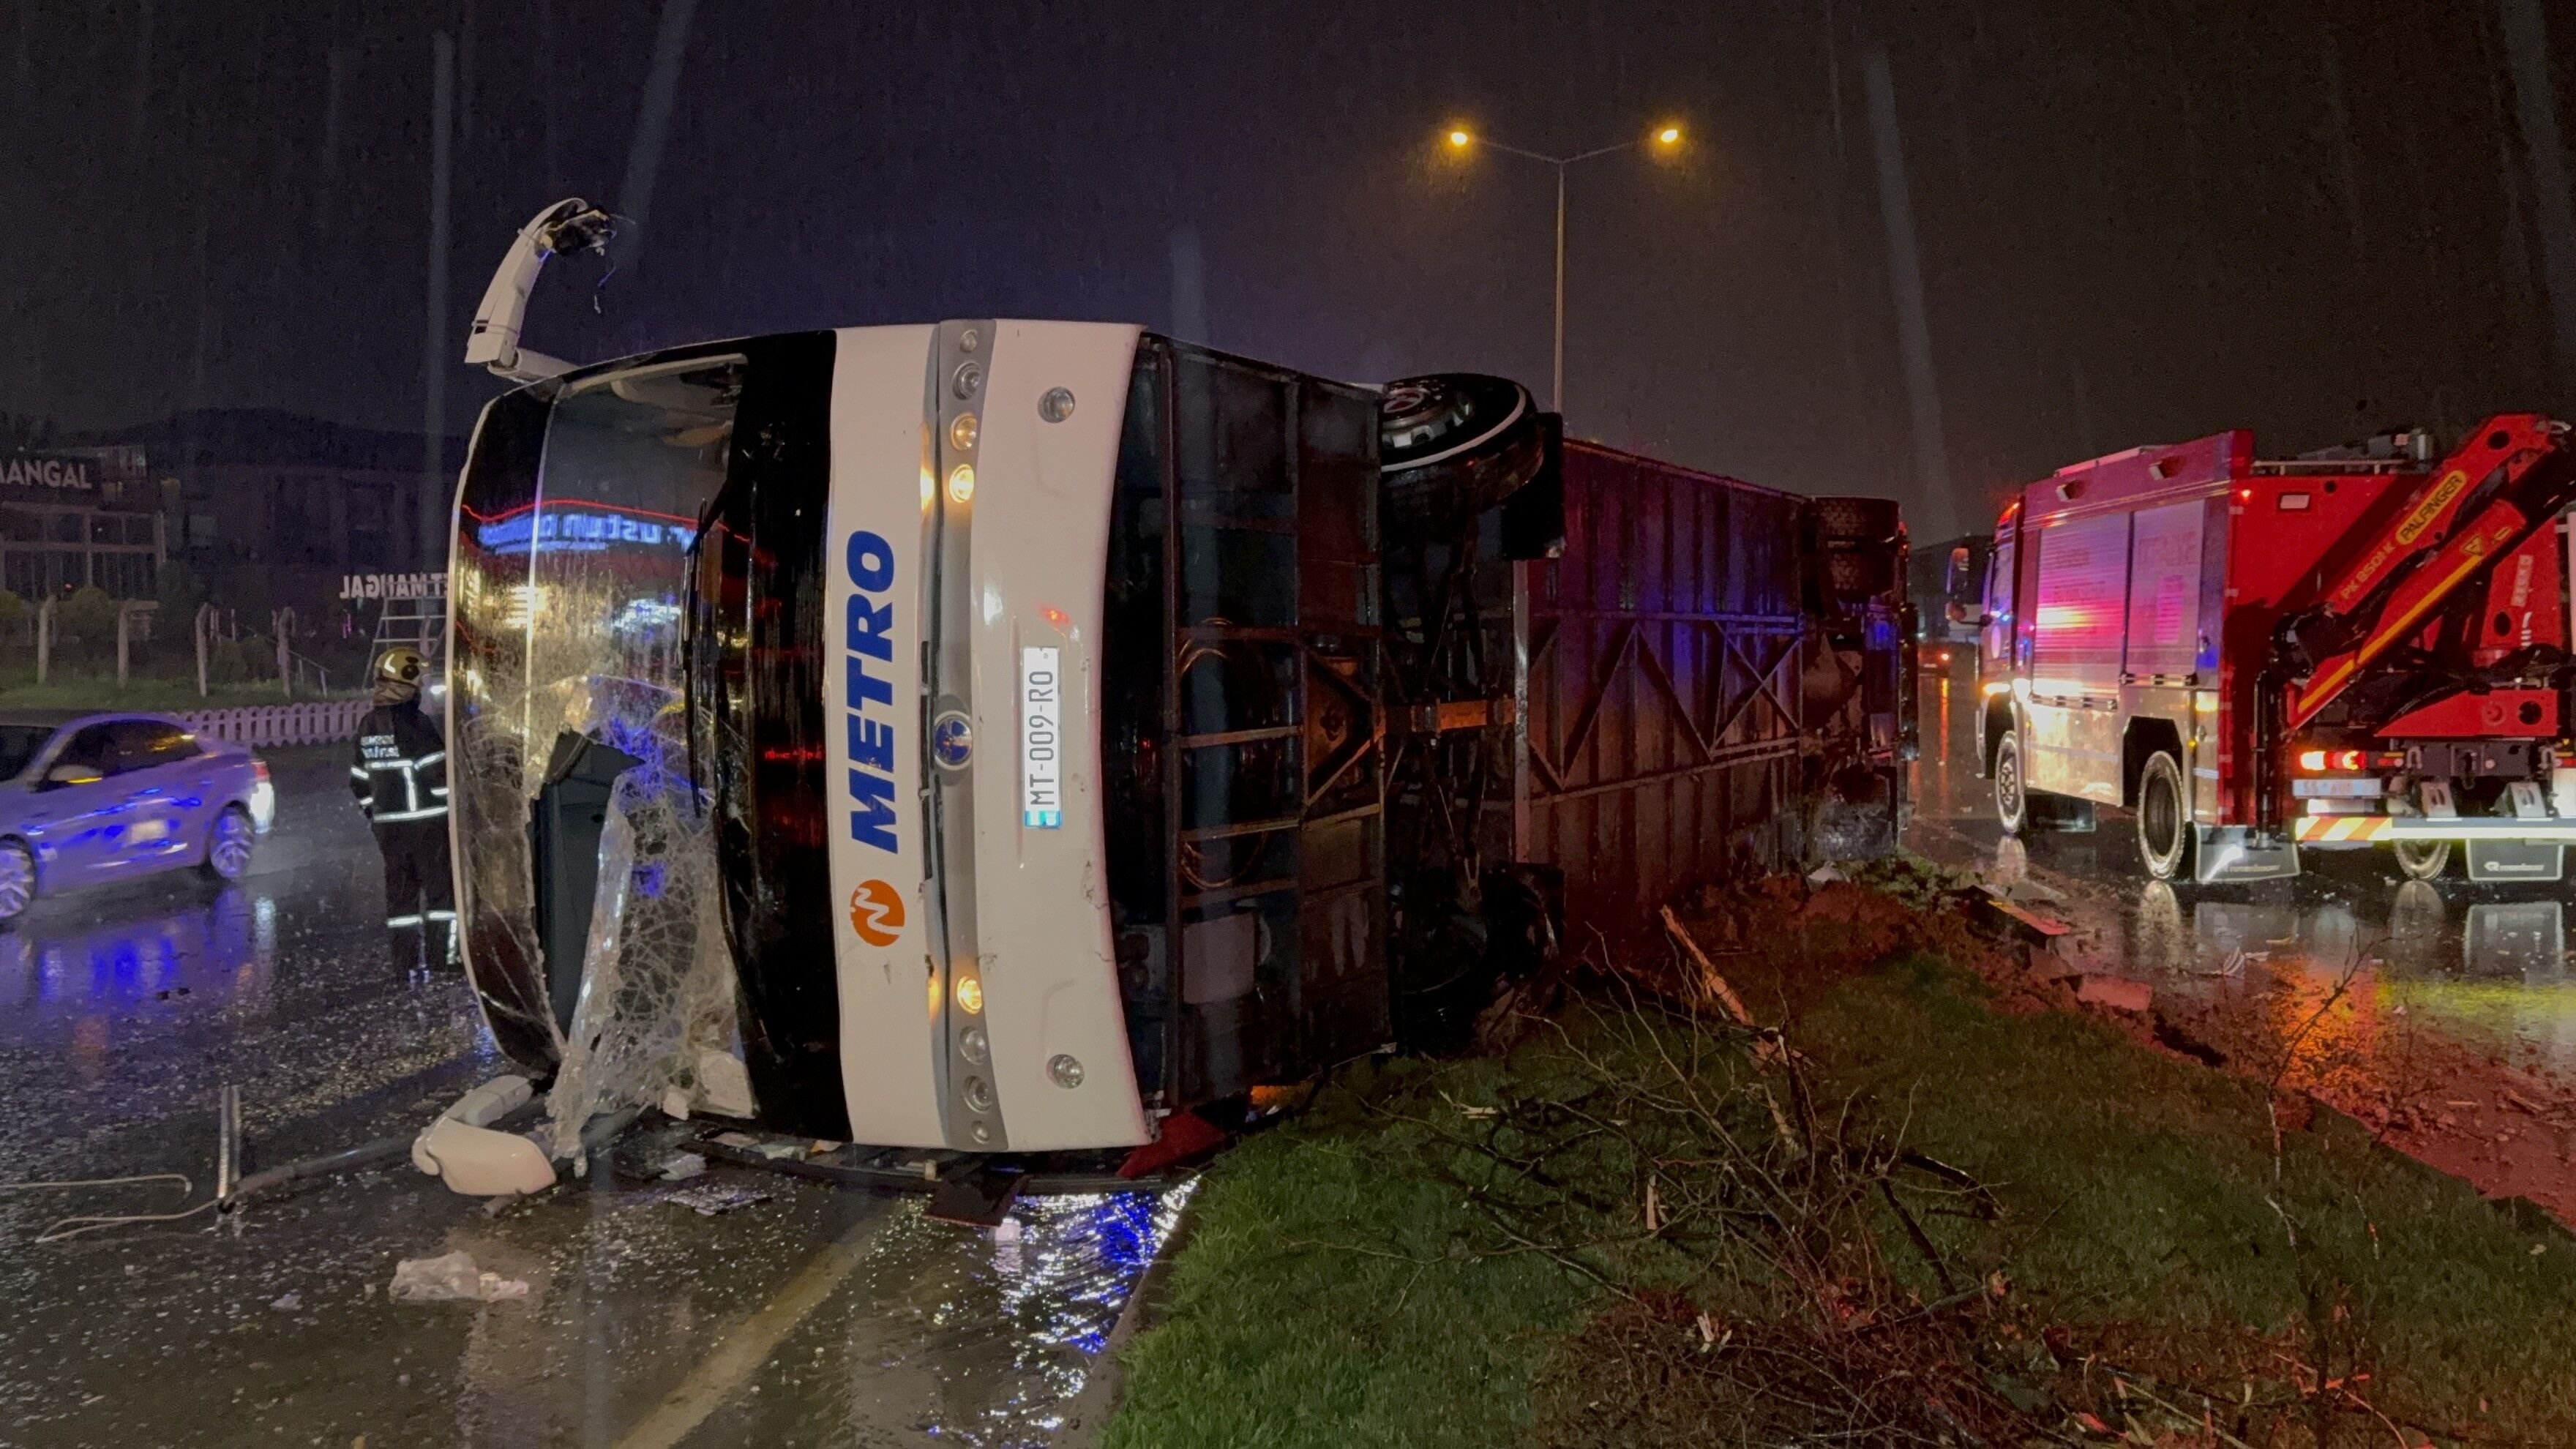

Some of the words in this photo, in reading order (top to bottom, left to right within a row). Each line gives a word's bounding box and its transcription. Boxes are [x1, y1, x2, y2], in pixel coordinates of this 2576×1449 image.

[0, 458, 92, 490] ANGAL
[846, 530, 898, 855] METRO
[1028, 670, 1055, 805] MT-009-RO
